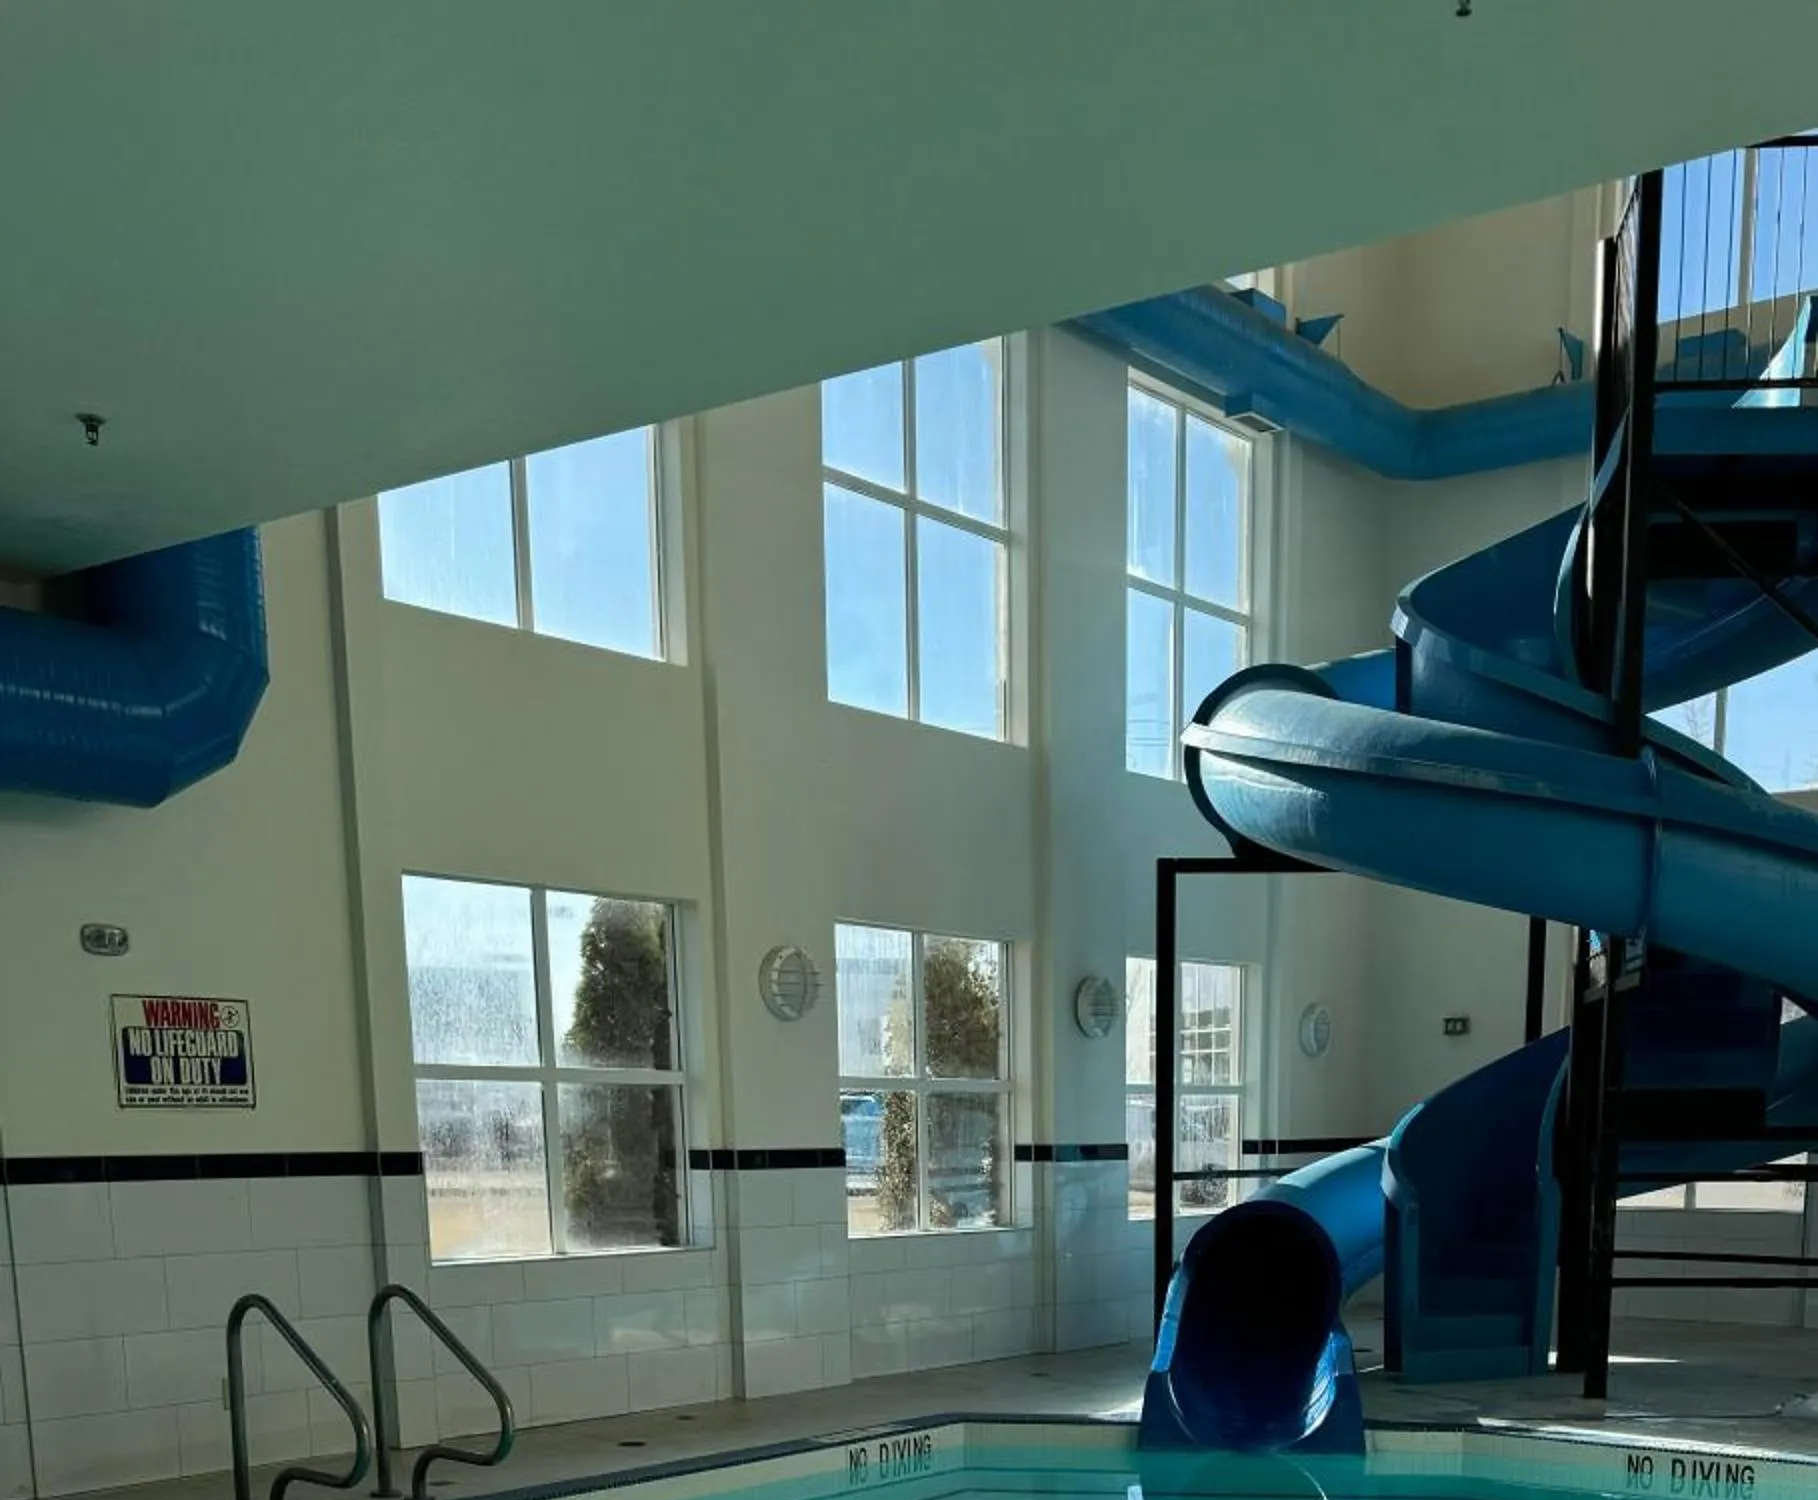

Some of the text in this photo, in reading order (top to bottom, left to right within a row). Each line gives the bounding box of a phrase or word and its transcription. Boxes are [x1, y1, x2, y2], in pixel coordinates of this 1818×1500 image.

[142, 1000, 220, 1028] WARNING
[129, 1029, 239, 1057] NO LIFEGUARD
[151, 1057, 221, 1085] ON DUTY
[849, 1434, 932, 1471] NO DIVING
[1627, 1453, 1756, 1485] NO DIVING
